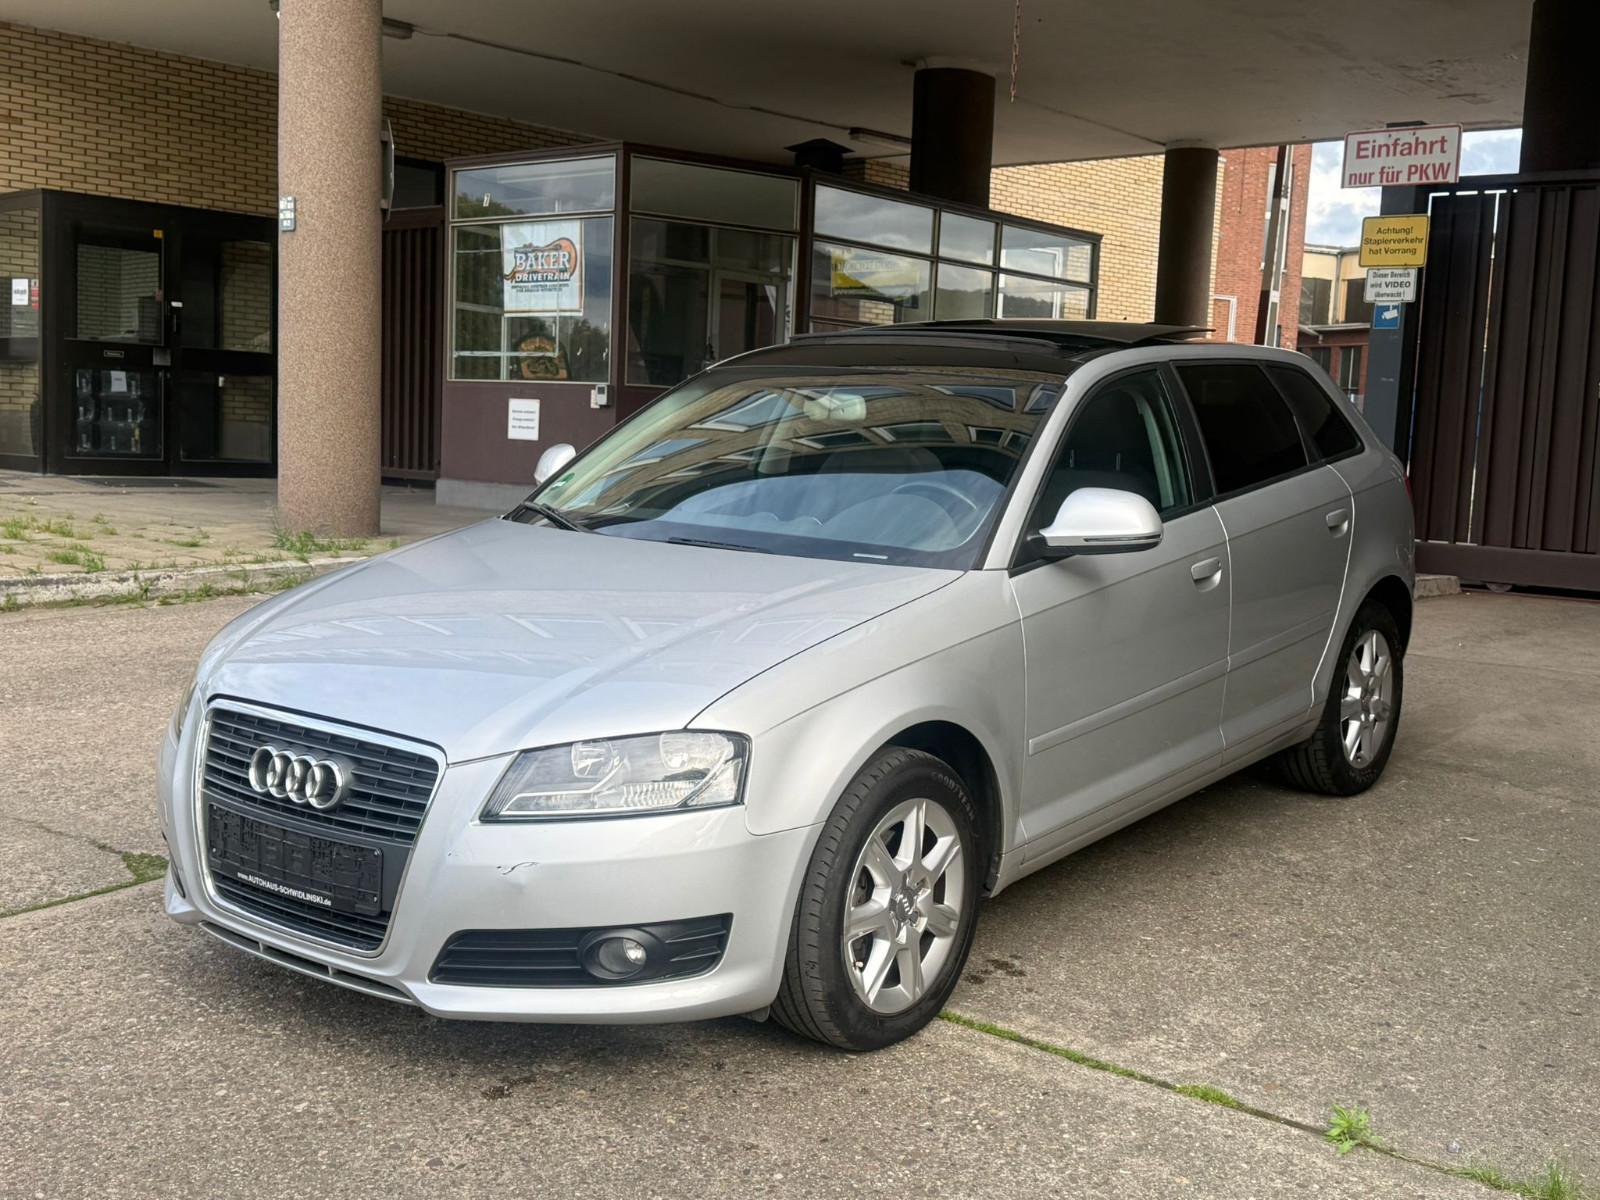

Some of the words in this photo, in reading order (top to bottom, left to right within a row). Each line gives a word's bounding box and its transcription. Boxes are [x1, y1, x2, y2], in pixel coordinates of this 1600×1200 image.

[1356, 135, 1448, 160] Einfahrt
[1348, 171, 1375, 186] nur
[1379, 166, 1403, 184] für
[1408, 162, 1451, 181] PKW
[1376, 226, 1414, 235] Achtung!
[1363, 236, 1424, 245] Staplerverkehr
[1384, 247, 1417, 255] Vorrang
[515, 251, 570, 271] BAKER
[515, 272, 570, 282] DRIVETRAIN
